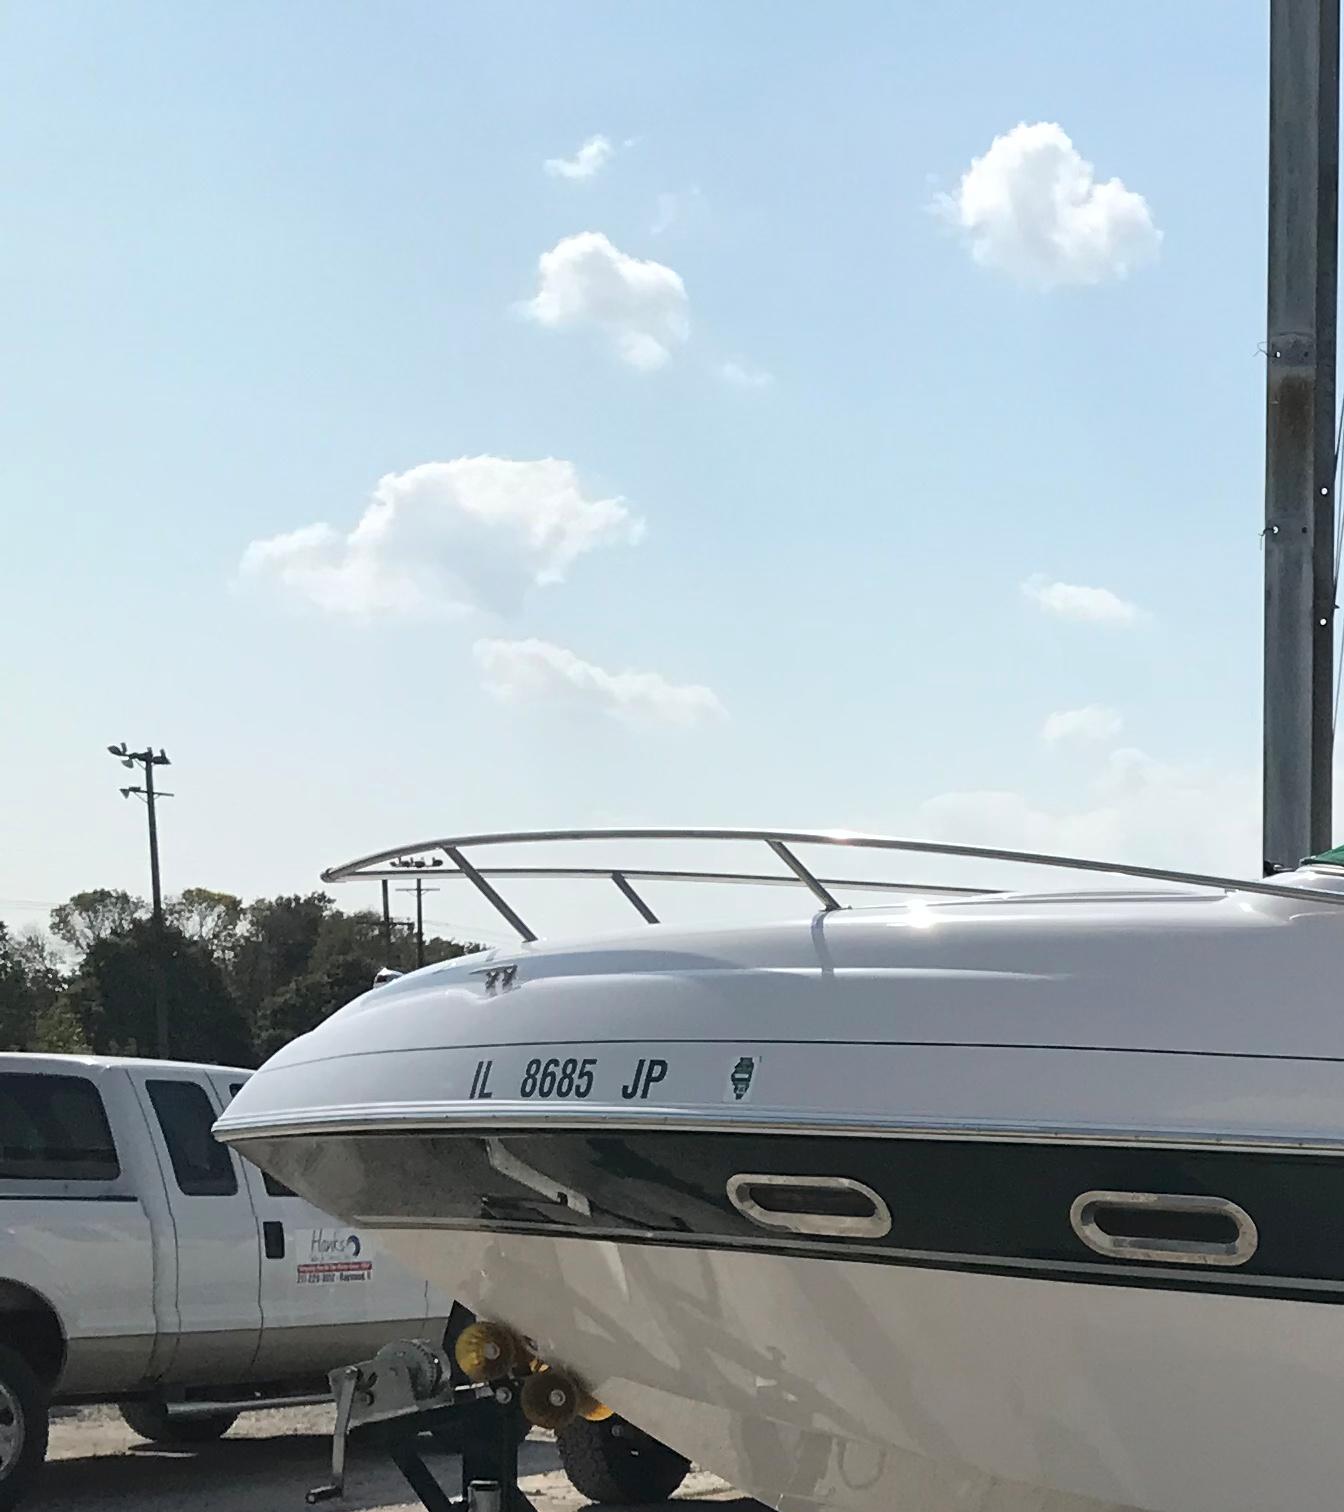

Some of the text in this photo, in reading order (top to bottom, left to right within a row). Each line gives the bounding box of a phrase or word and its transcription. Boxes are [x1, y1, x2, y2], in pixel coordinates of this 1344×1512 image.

[469, 1058, 669, 1099] IL 8685 JP
